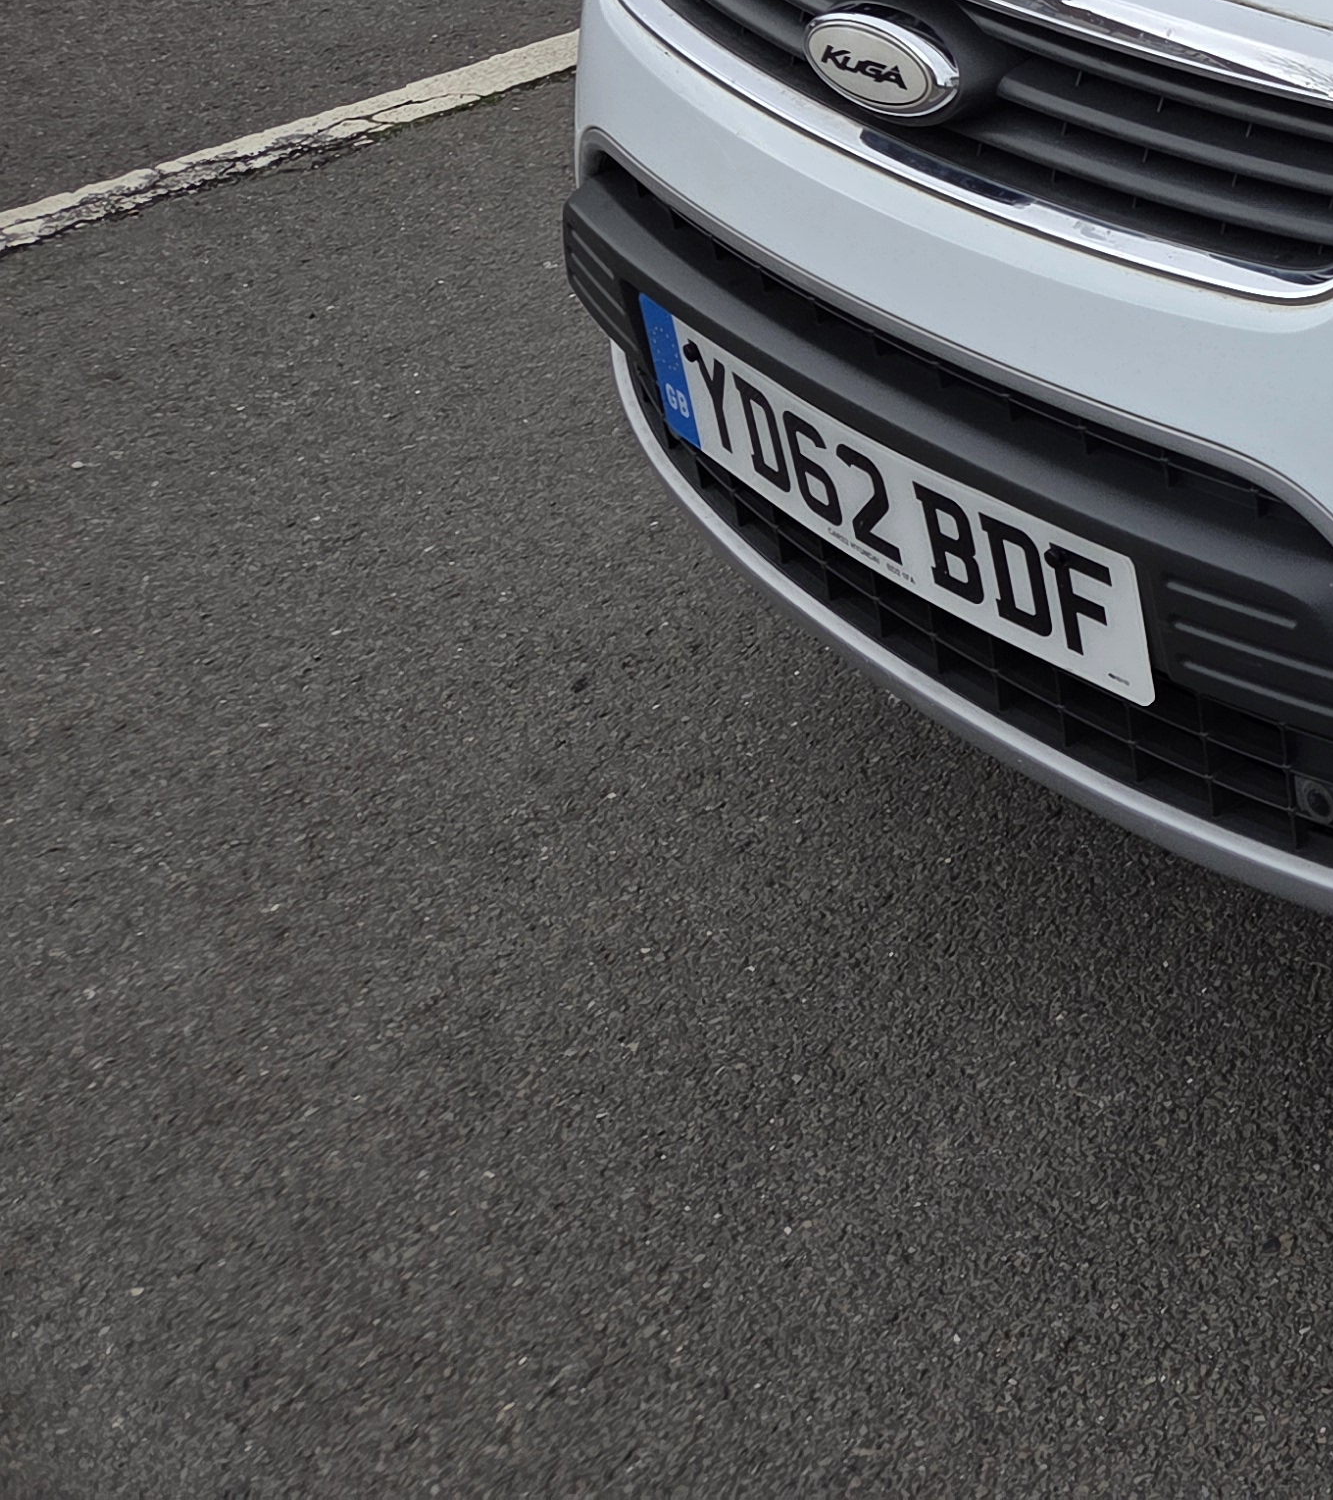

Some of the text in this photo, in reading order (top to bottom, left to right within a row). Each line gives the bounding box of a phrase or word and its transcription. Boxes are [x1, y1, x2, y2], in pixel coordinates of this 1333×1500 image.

[665, 382, 690, 418] GB
[687, 338, 1113, 656] YD62 BDF
